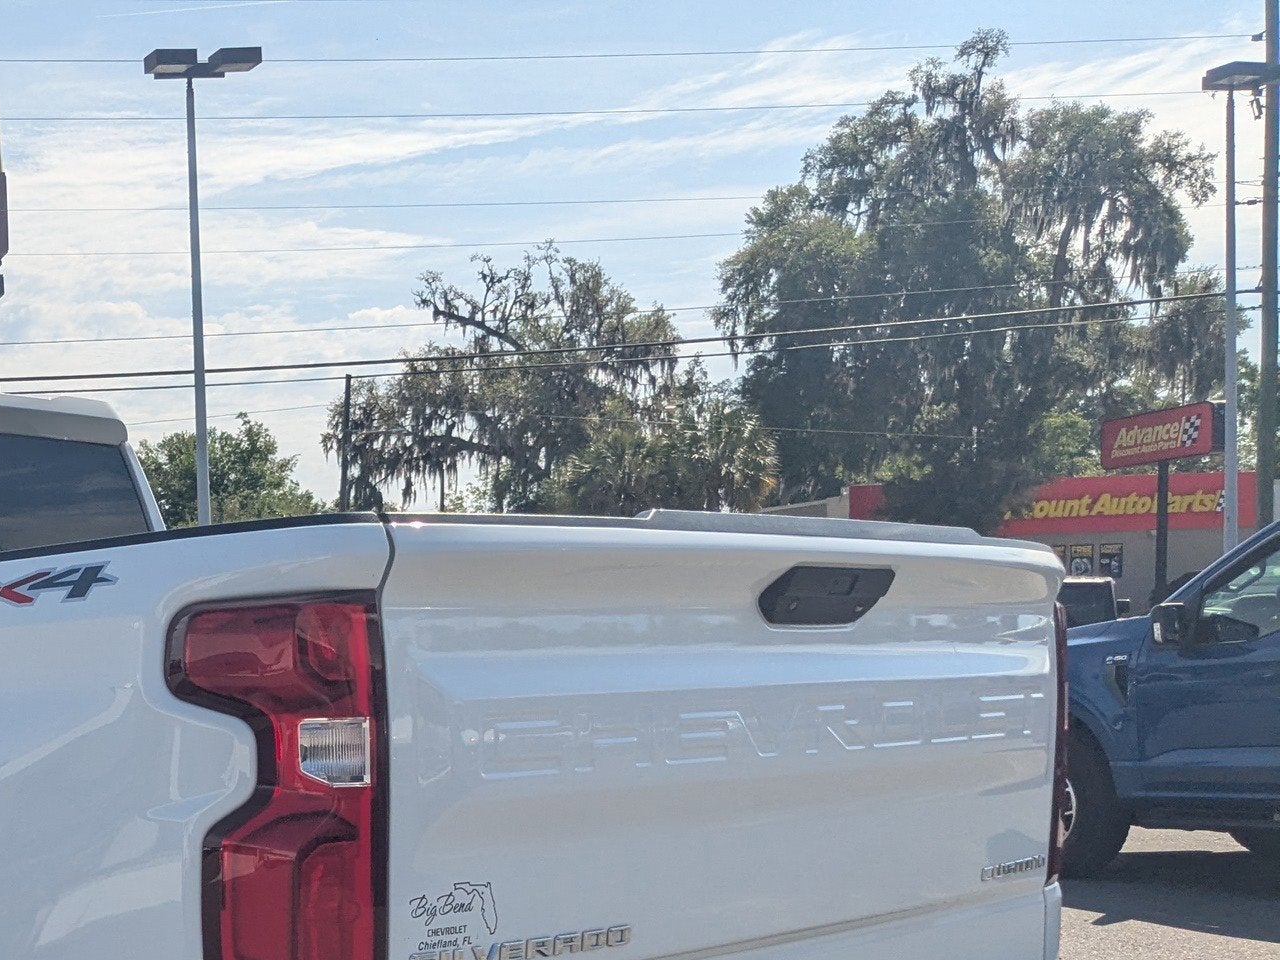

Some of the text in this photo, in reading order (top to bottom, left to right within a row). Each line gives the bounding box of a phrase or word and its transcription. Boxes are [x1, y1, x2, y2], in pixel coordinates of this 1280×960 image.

[1113, 422, 1180, 449] Advance
[1158, 441, 1177, 450] Parts
[1091, 493, 1152, 516] Auto
[409, 892, 476, 926] Big Bend
[427, 925, 467, 938] CHEVROLET
[462, 936, 472, 946] FL
